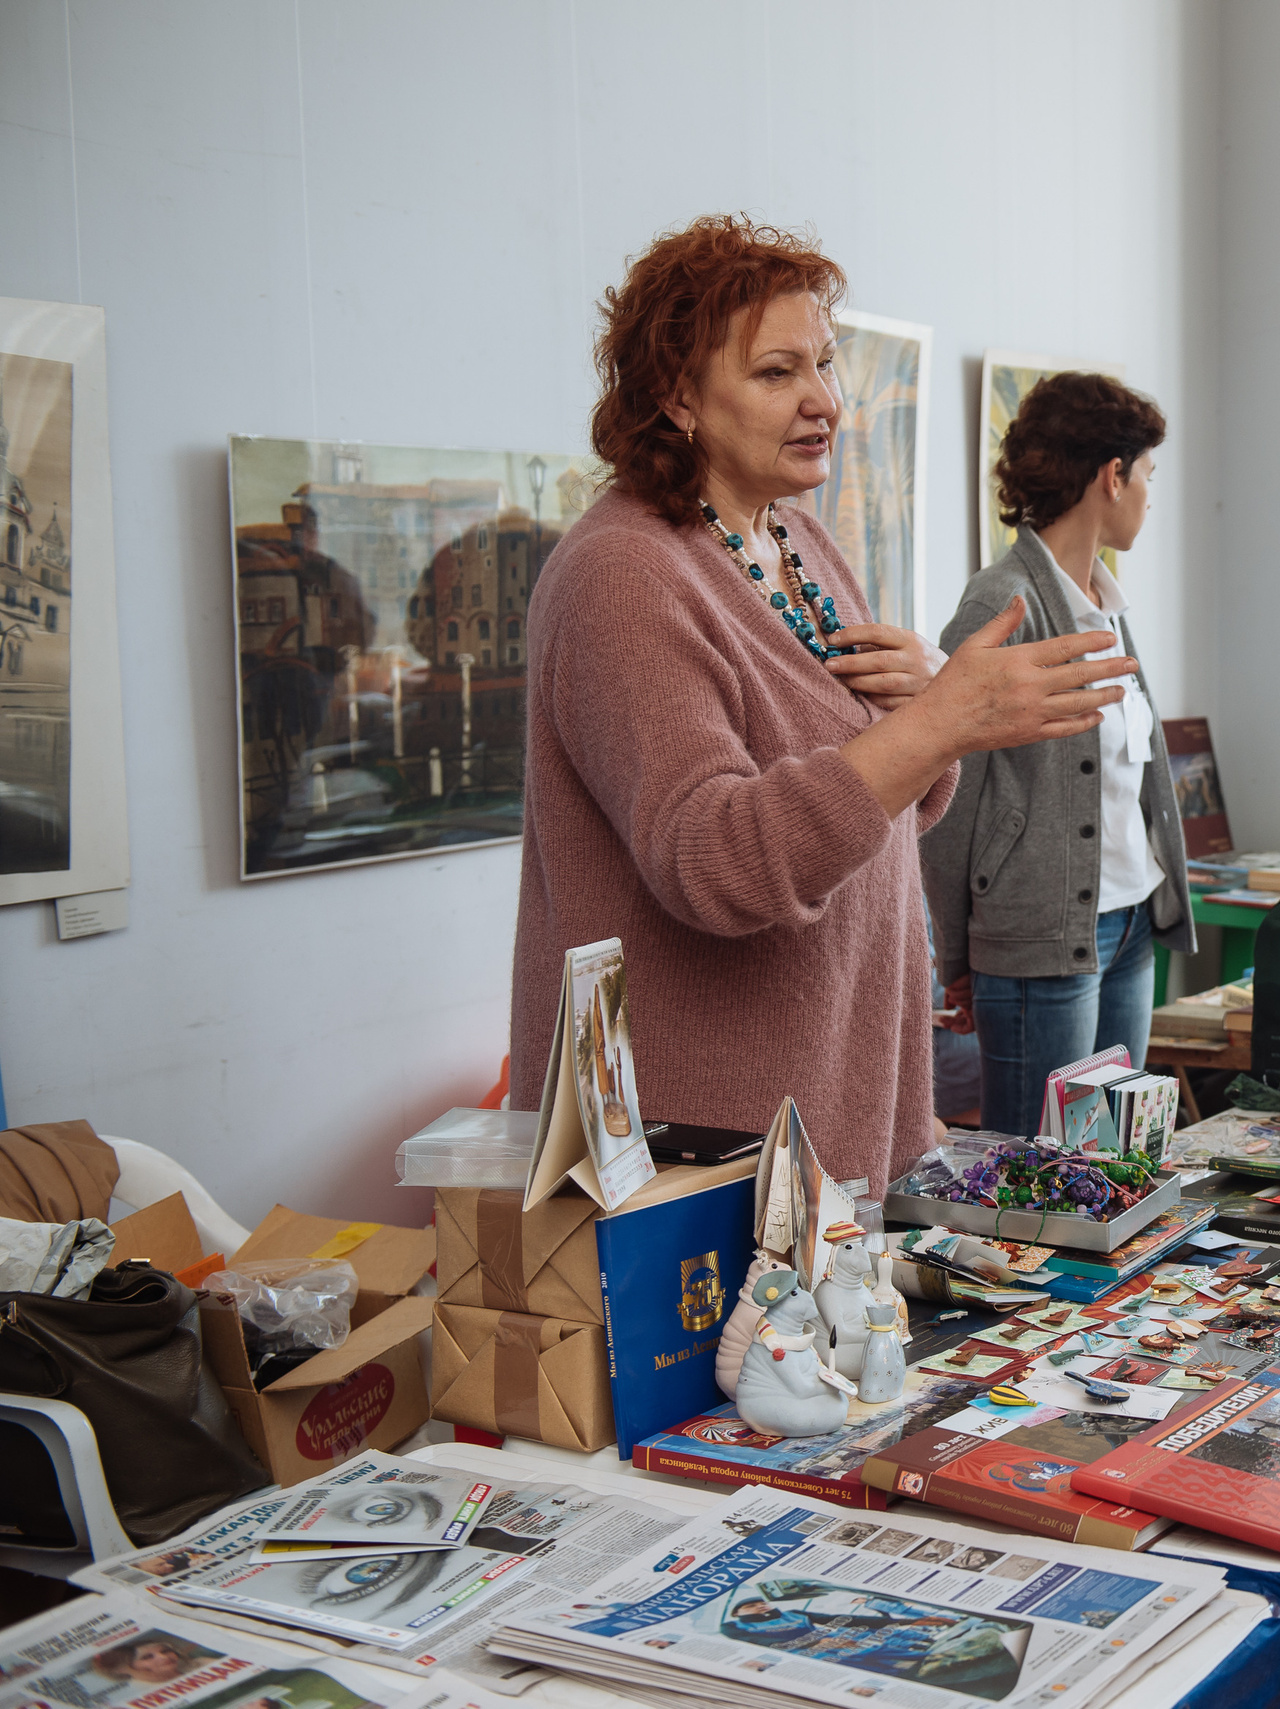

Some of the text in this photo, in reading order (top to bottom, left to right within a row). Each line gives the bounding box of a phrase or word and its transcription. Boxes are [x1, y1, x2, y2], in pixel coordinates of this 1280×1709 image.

[1244, 1226, 1267, 1234] месяца
[604, 1296, 614, 1348] Ленинского
[654, 1336, 722, 1371] Мы из Лени
[610, 1363, 617, 1379] Мы
[324, 1405, 381, 1449] ПЕЛЬМЕНИ
[659, 1457, 852, 1499] 75 лет Советскому району города Челябинска
[194, 1515, 254, 1547] КАКАЯ
[1038, 1516, 1059, 1527] лет
[1060, 1522, 1074, 1535] 80
[215, 1541, 240, 1555] ОТ
[616, 1544, 752, 1618] ЮЖНОУРАЛЬСКАЯ
[630, 1541, 796, 1624] ПАНОРАМА
